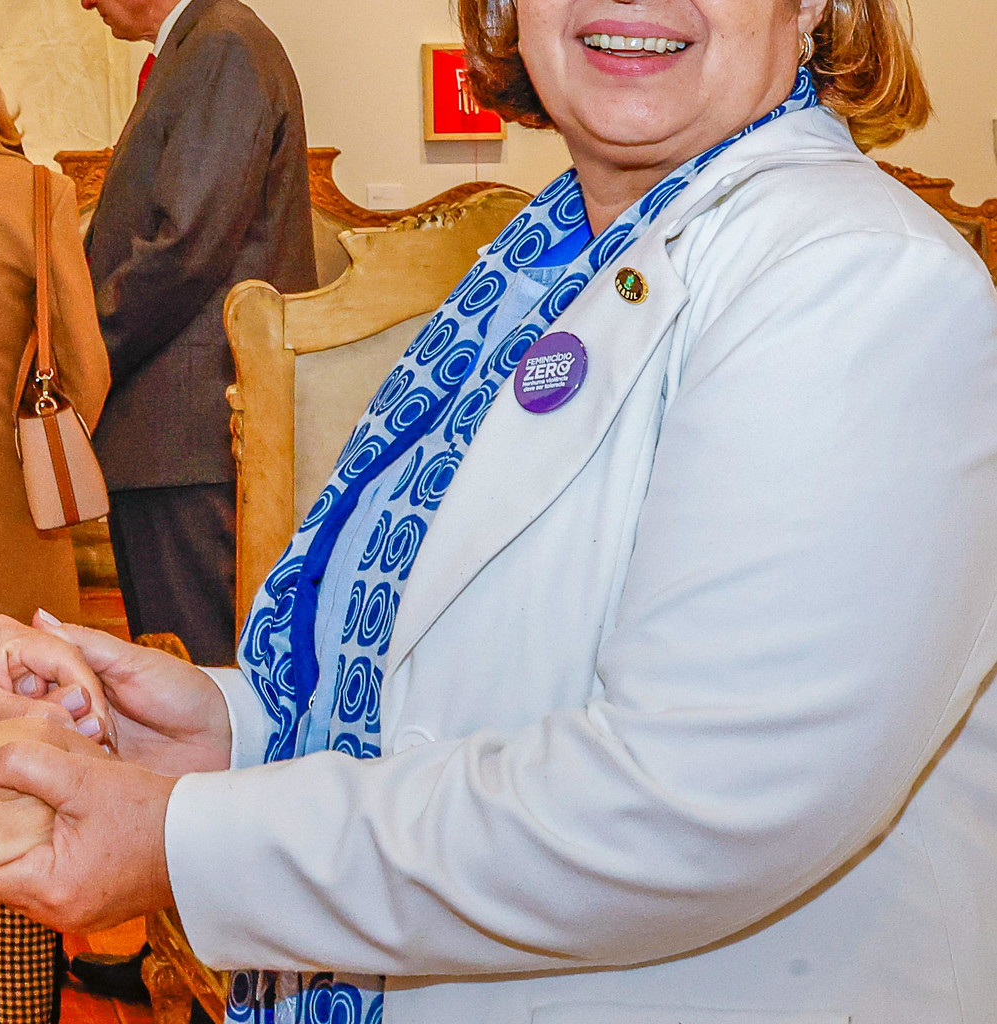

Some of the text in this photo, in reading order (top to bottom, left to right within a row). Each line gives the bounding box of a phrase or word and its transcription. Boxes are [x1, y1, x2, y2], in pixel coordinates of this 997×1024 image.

[615, 278, 638, 300] BRASIL
[524, 359, 573, 381] ZERO
[526, 352, 573, 367] FEMINICÍDIO
